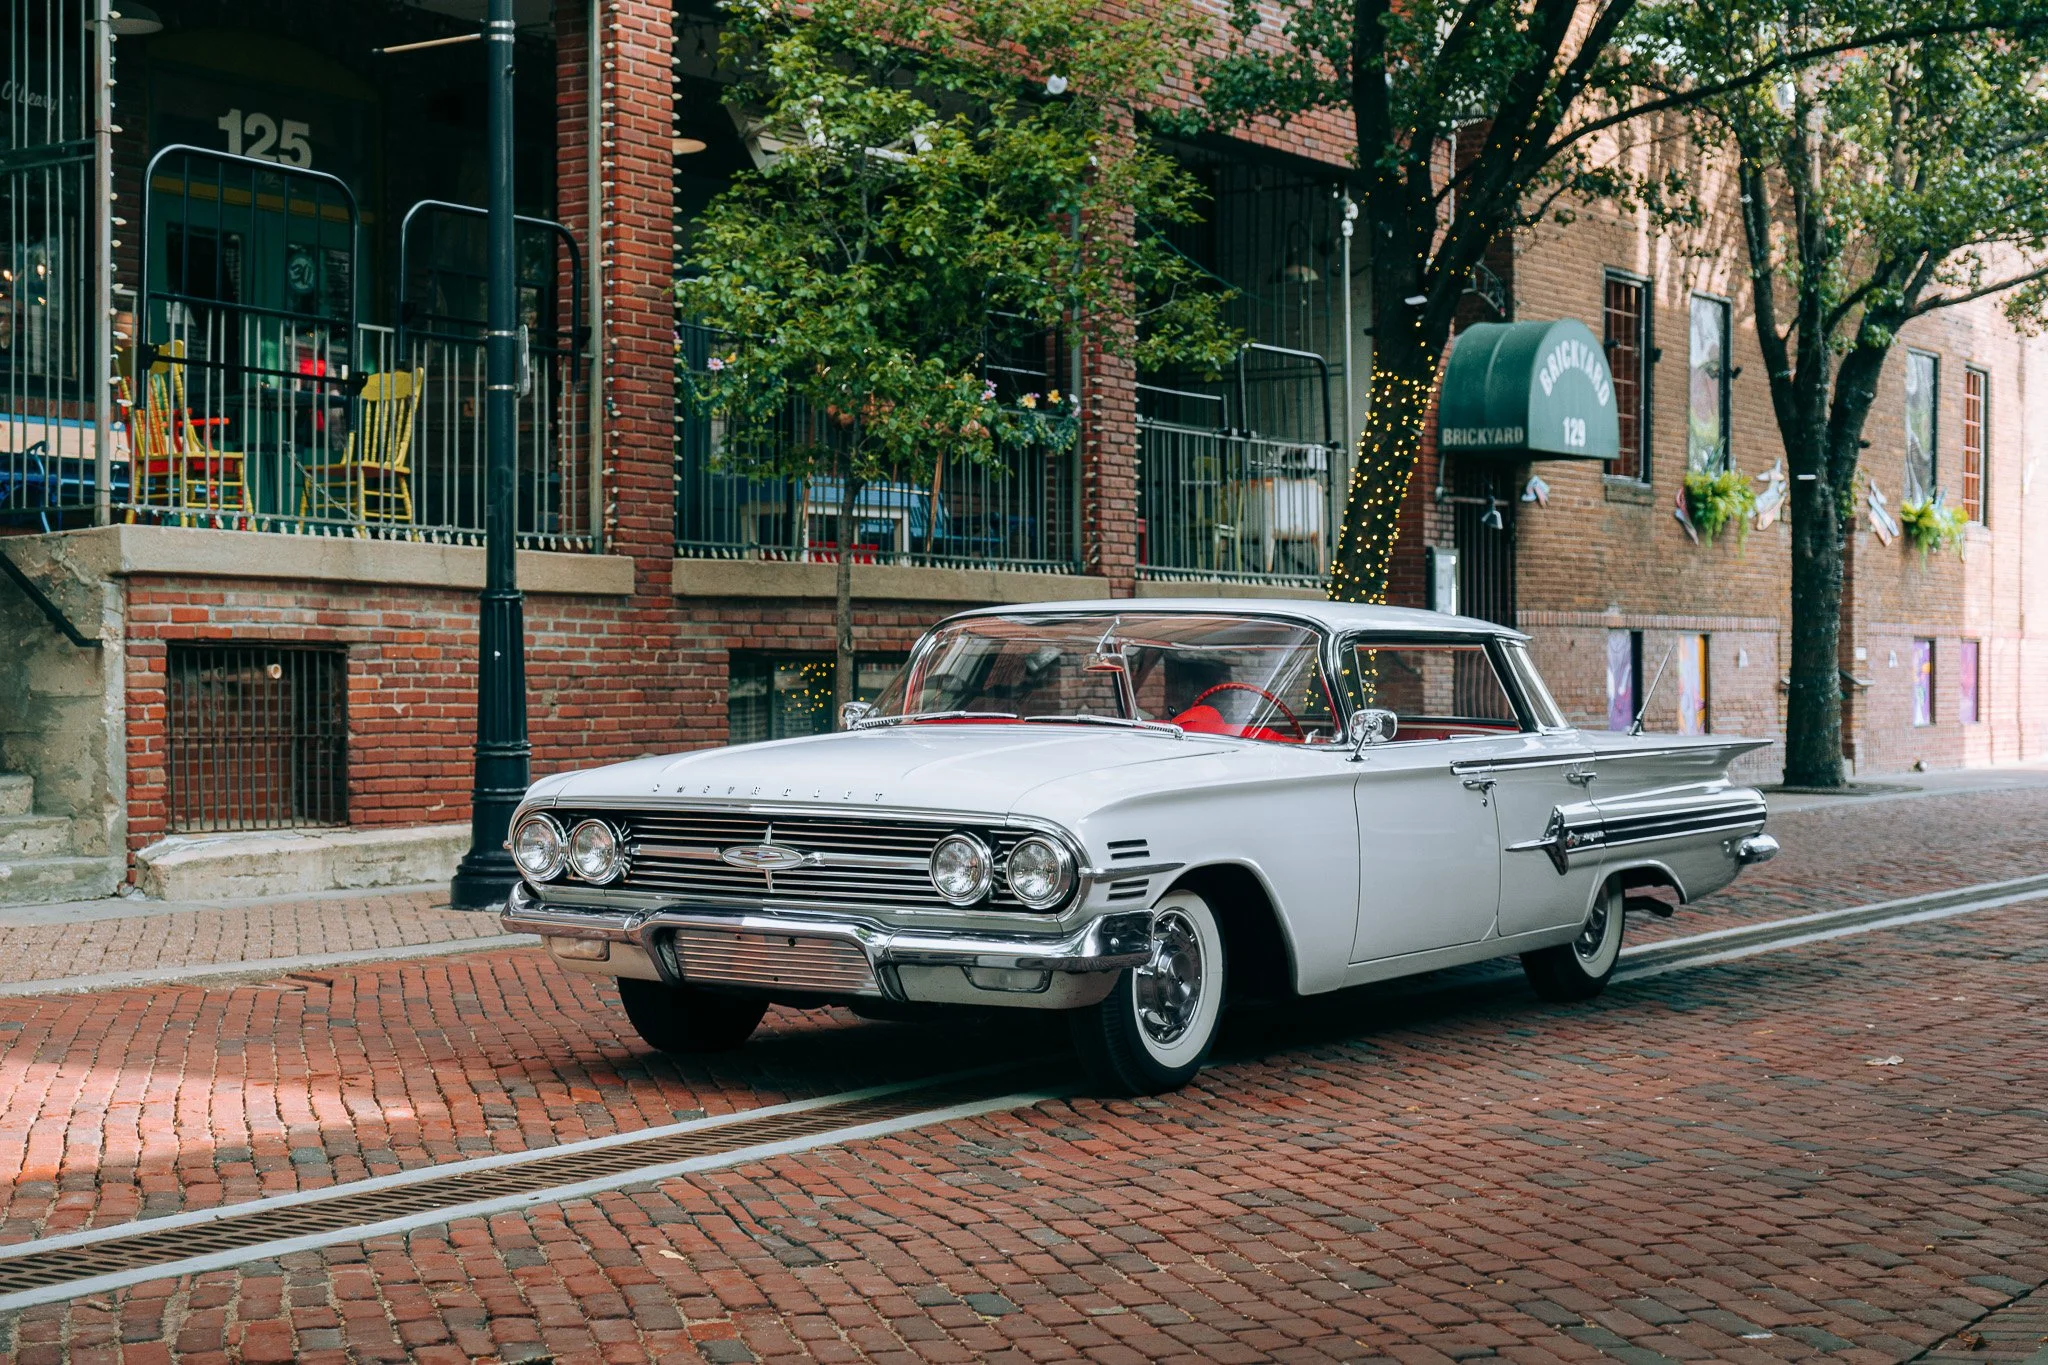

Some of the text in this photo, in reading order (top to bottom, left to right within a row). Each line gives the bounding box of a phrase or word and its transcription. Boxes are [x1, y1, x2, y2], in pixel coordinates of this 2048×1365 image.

[218, 108, 312, 169] 125
[1539, 339, 1611, 407] BRICKYARD
[1442, 427, 1524, 446] BRICKYARD
[1562, 416, 1586, 447] 129
